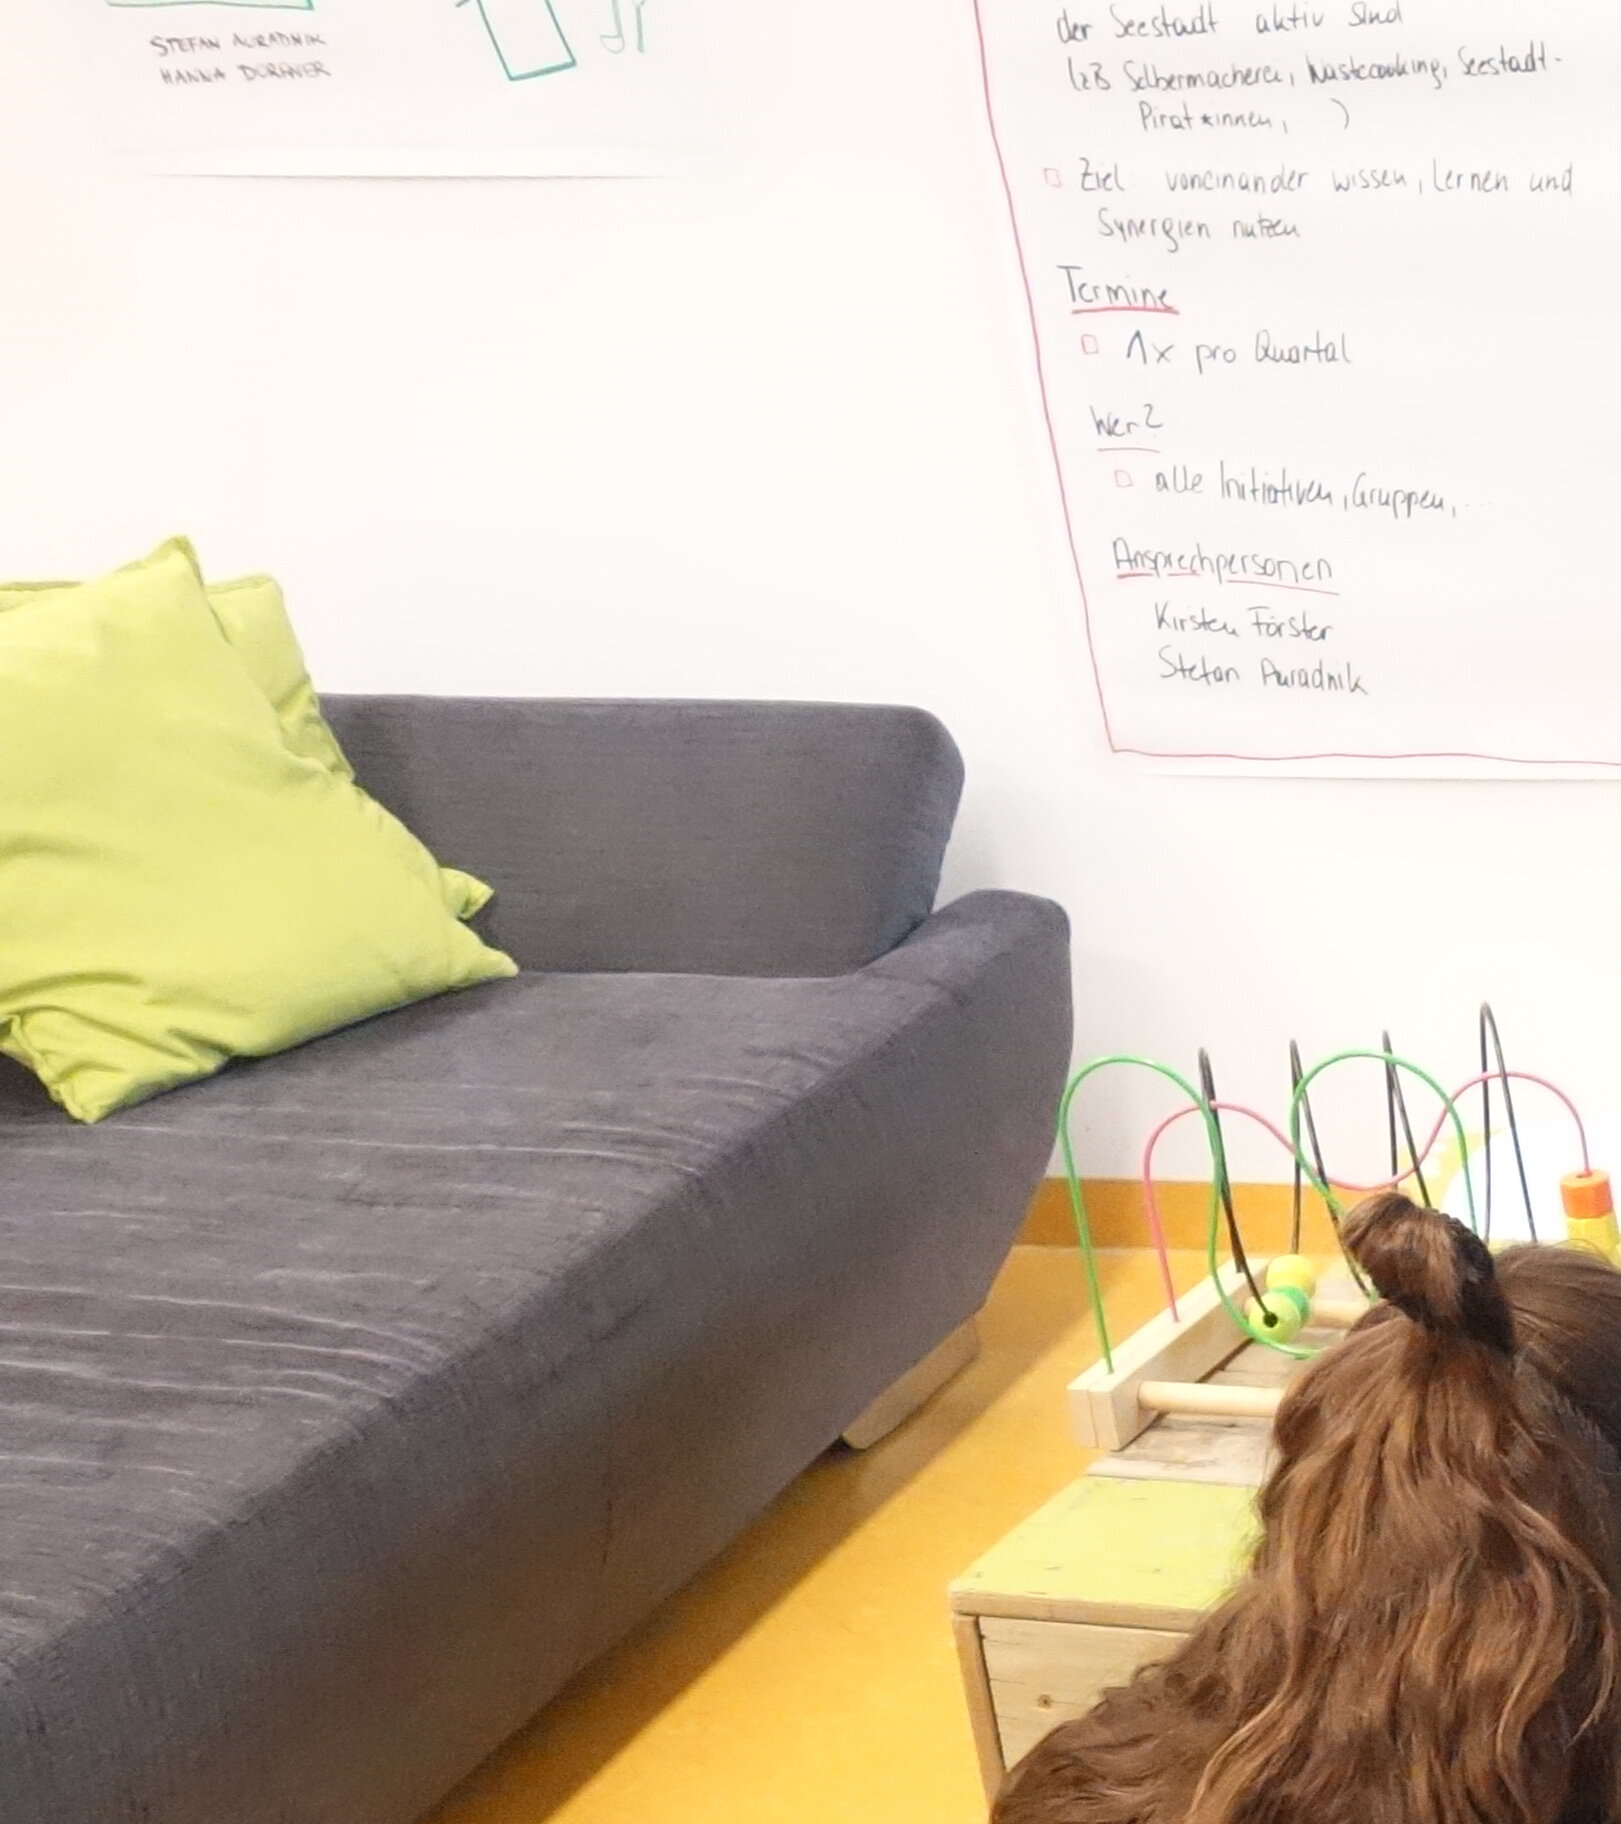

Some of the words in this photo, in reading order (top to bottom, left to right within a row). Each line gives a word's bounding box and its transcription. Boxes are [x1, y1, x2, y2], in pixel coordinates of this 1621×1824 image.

[1056, 9, 1092, 44] der
[1109, 2, 1218, 38] Seestadt
[1256, 4, 1323, 34] aktiv
[1166, 166, 1308, 194] voneinander
[1530, 165, 1572, 194] und
[1098, 207, 1210, 254] Synergien
[1233, 214, 1300, 238] nutzen
[1058, 264, 1175, 308] Termine
[1195, 344, 1237, 375] pro
[1255, 329, 1350, 364] Quartal
[1090, 403, 1163, 437] Wer?
[1155, 465, 1203, 493] alle
[1112, 538, 1332, 582] Ansprechpersonen
[1155, 602, 1239, 637] Kirsten
[1158, 645, 1240, 686] Stefan
[1261, 657, 1368, 695] Auradnik
